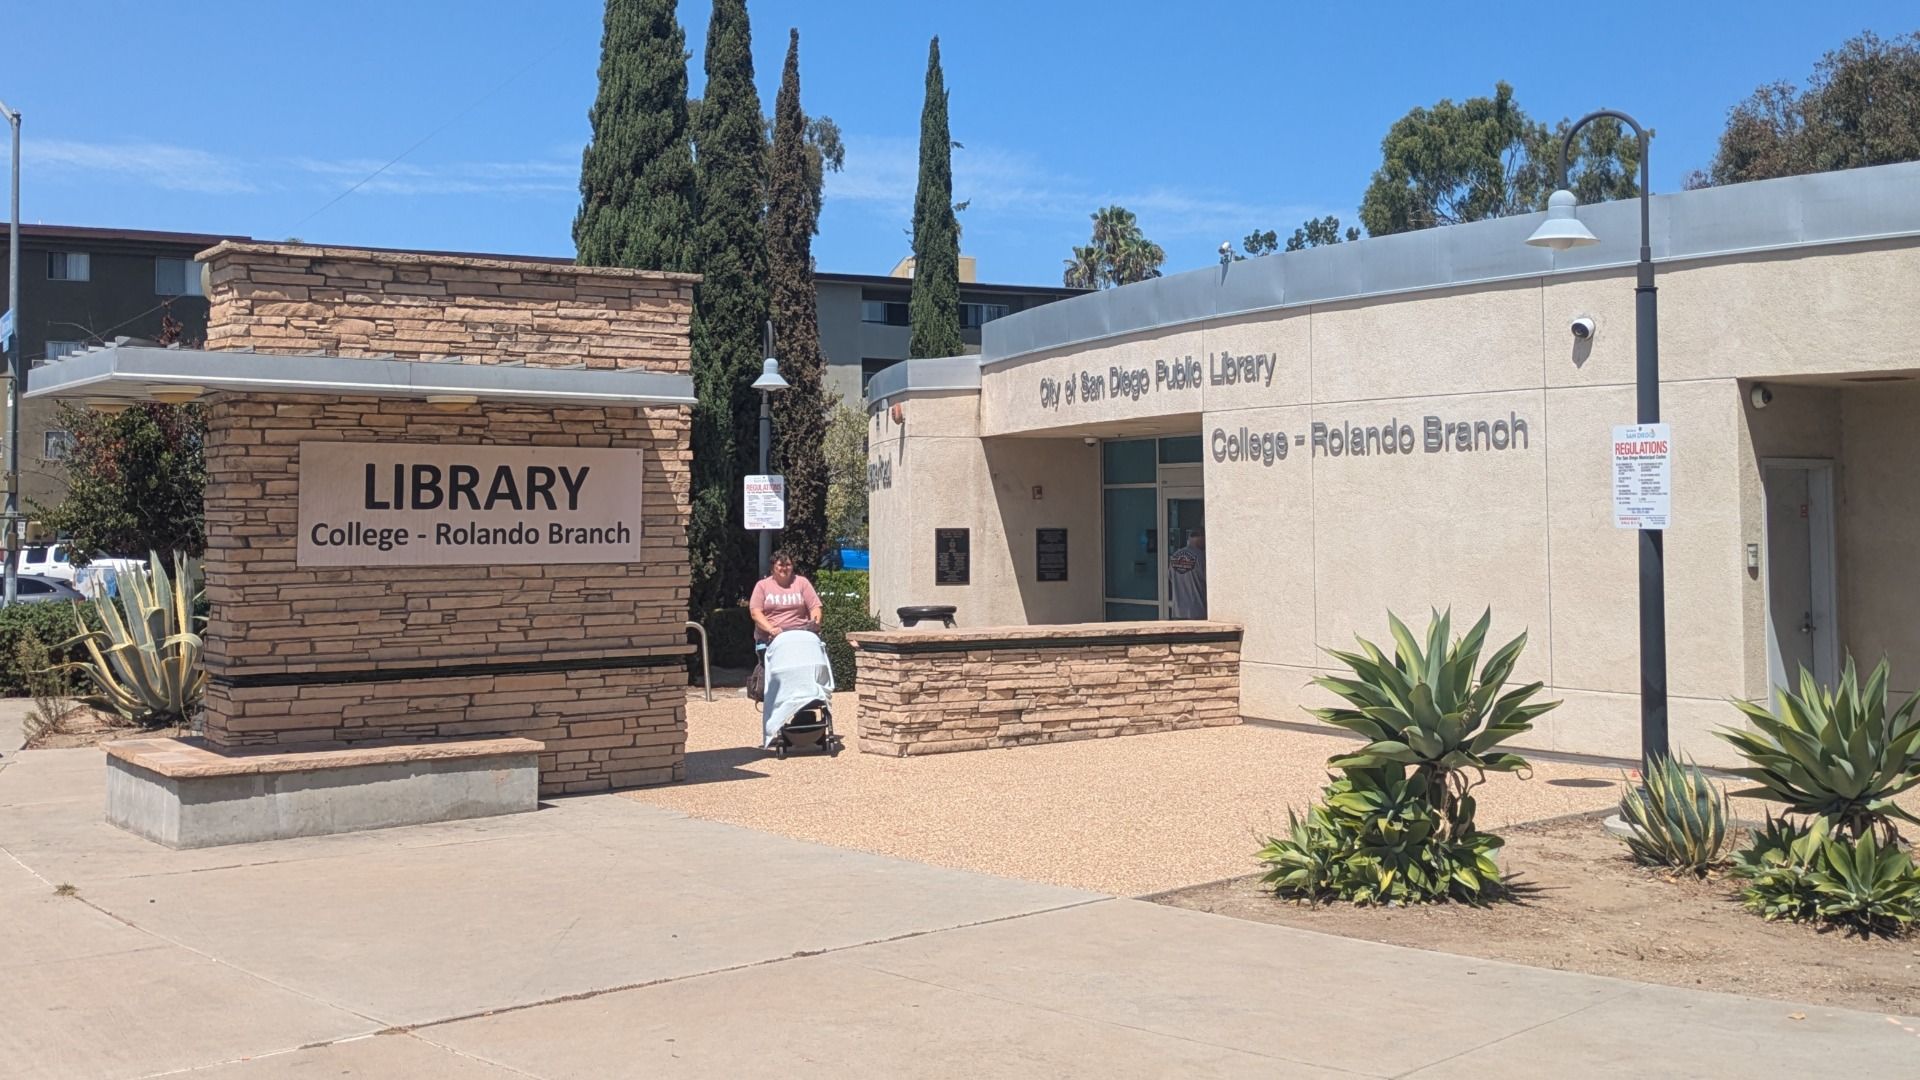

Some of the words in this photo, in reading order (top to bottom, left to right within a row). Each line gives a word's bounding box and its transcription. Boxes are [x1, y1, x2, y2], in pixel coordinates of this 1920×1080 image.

[1039, 376, 1061, 412] City
[1065, 372, 1077, 405] of
[1080, 369, 1105, 402] San
[1109, 364, 1150, 401] Diego
[1155, 355, 1202, 391] Public
[1210, 351, 1277, 387] Library
[1211, 426, 1288, 467] College
[1311, 417, 1415, 458] Rolando
[1423, 411, 1528, 453] Branch
[1615, 441, 1668, 455] REGULATIONS
[364, 463, 591, 511] LIBRARY
[311, 522, 409, 551] College
[435, 522, 540, 546] Rolando
[548, 521, 631, 545] Branch
